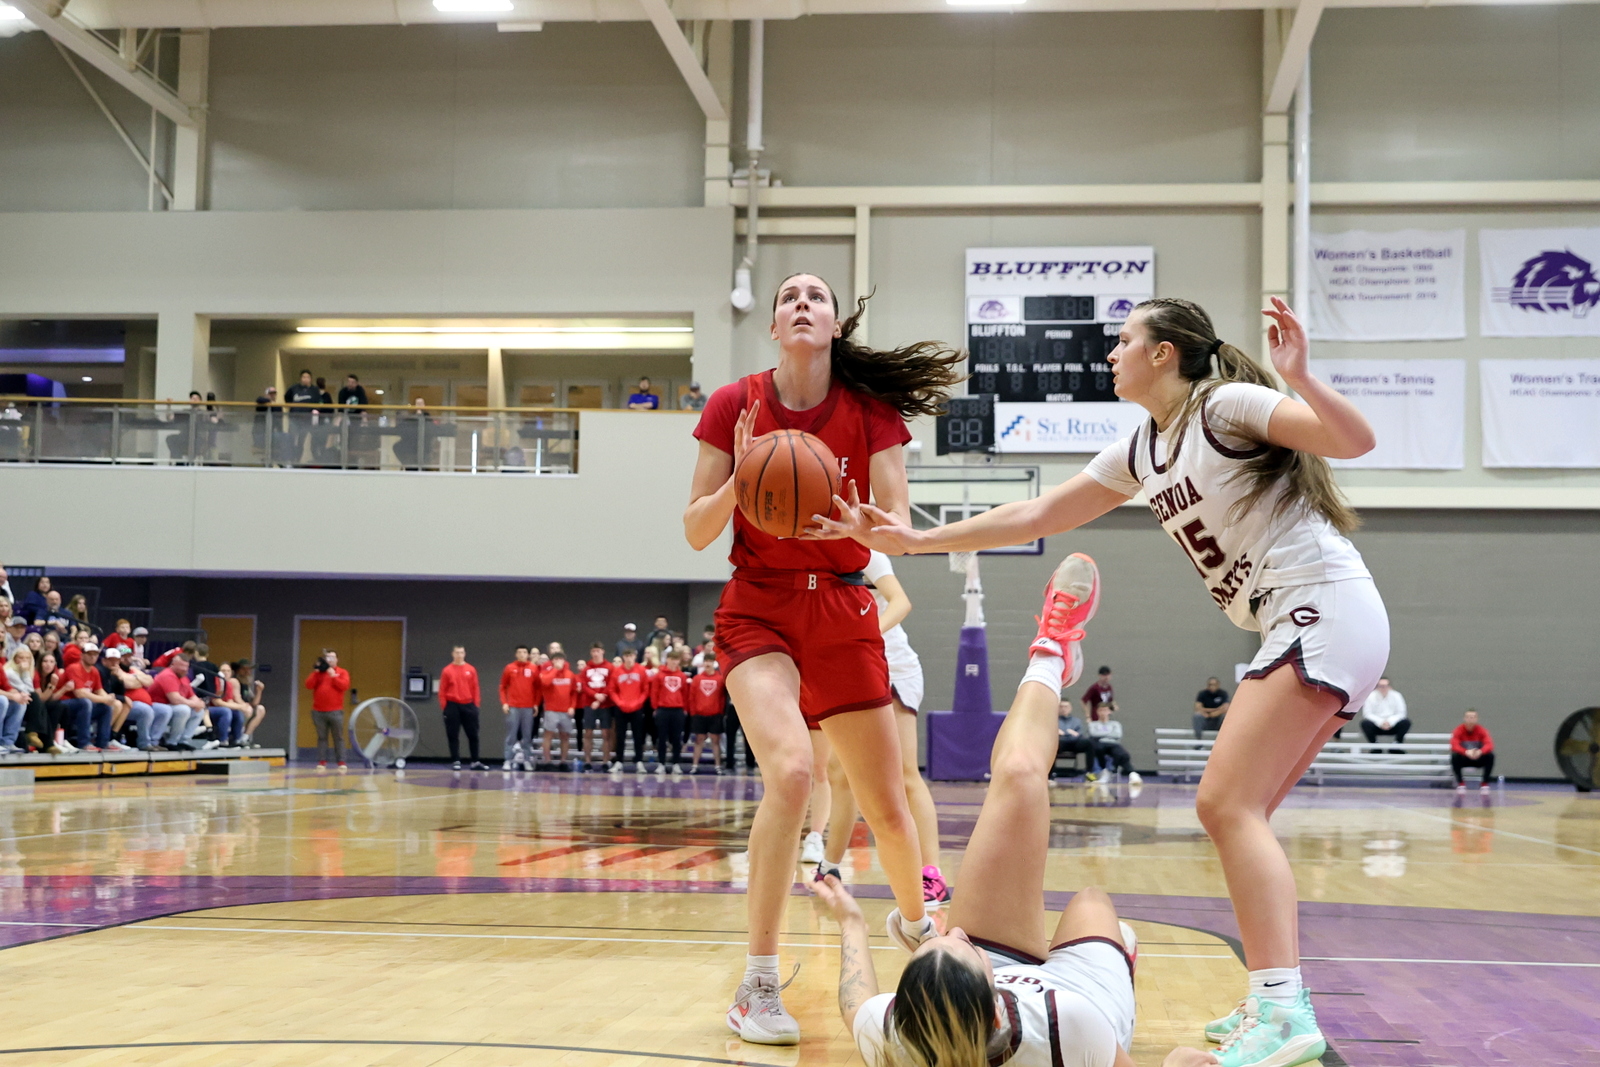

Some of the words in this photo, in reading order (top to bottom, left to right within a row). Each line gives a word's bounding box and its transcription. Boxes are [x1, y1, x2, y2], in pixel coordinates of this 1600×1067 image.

[1314, 248, 1376, 260] Women's
[1381, 247, 1452, 259] Basketball
[969, 260, 1150, 275] BLUFFTON
[971, 324, 1026, 337] BLUFFTON
[1045, 330, 1073, 339] PERIOD
[1330, 373, 1389, 384] Women's
[1394, 373, 1436, 384] Tennis
[1511, 372, 1573, 384] Women's
[1150, 475, 1204, 525] GENOA
[1172, 515, 1226, 581] 15
[807, 573, 817, 590] B
[1289, 606, 1321, 628] G
